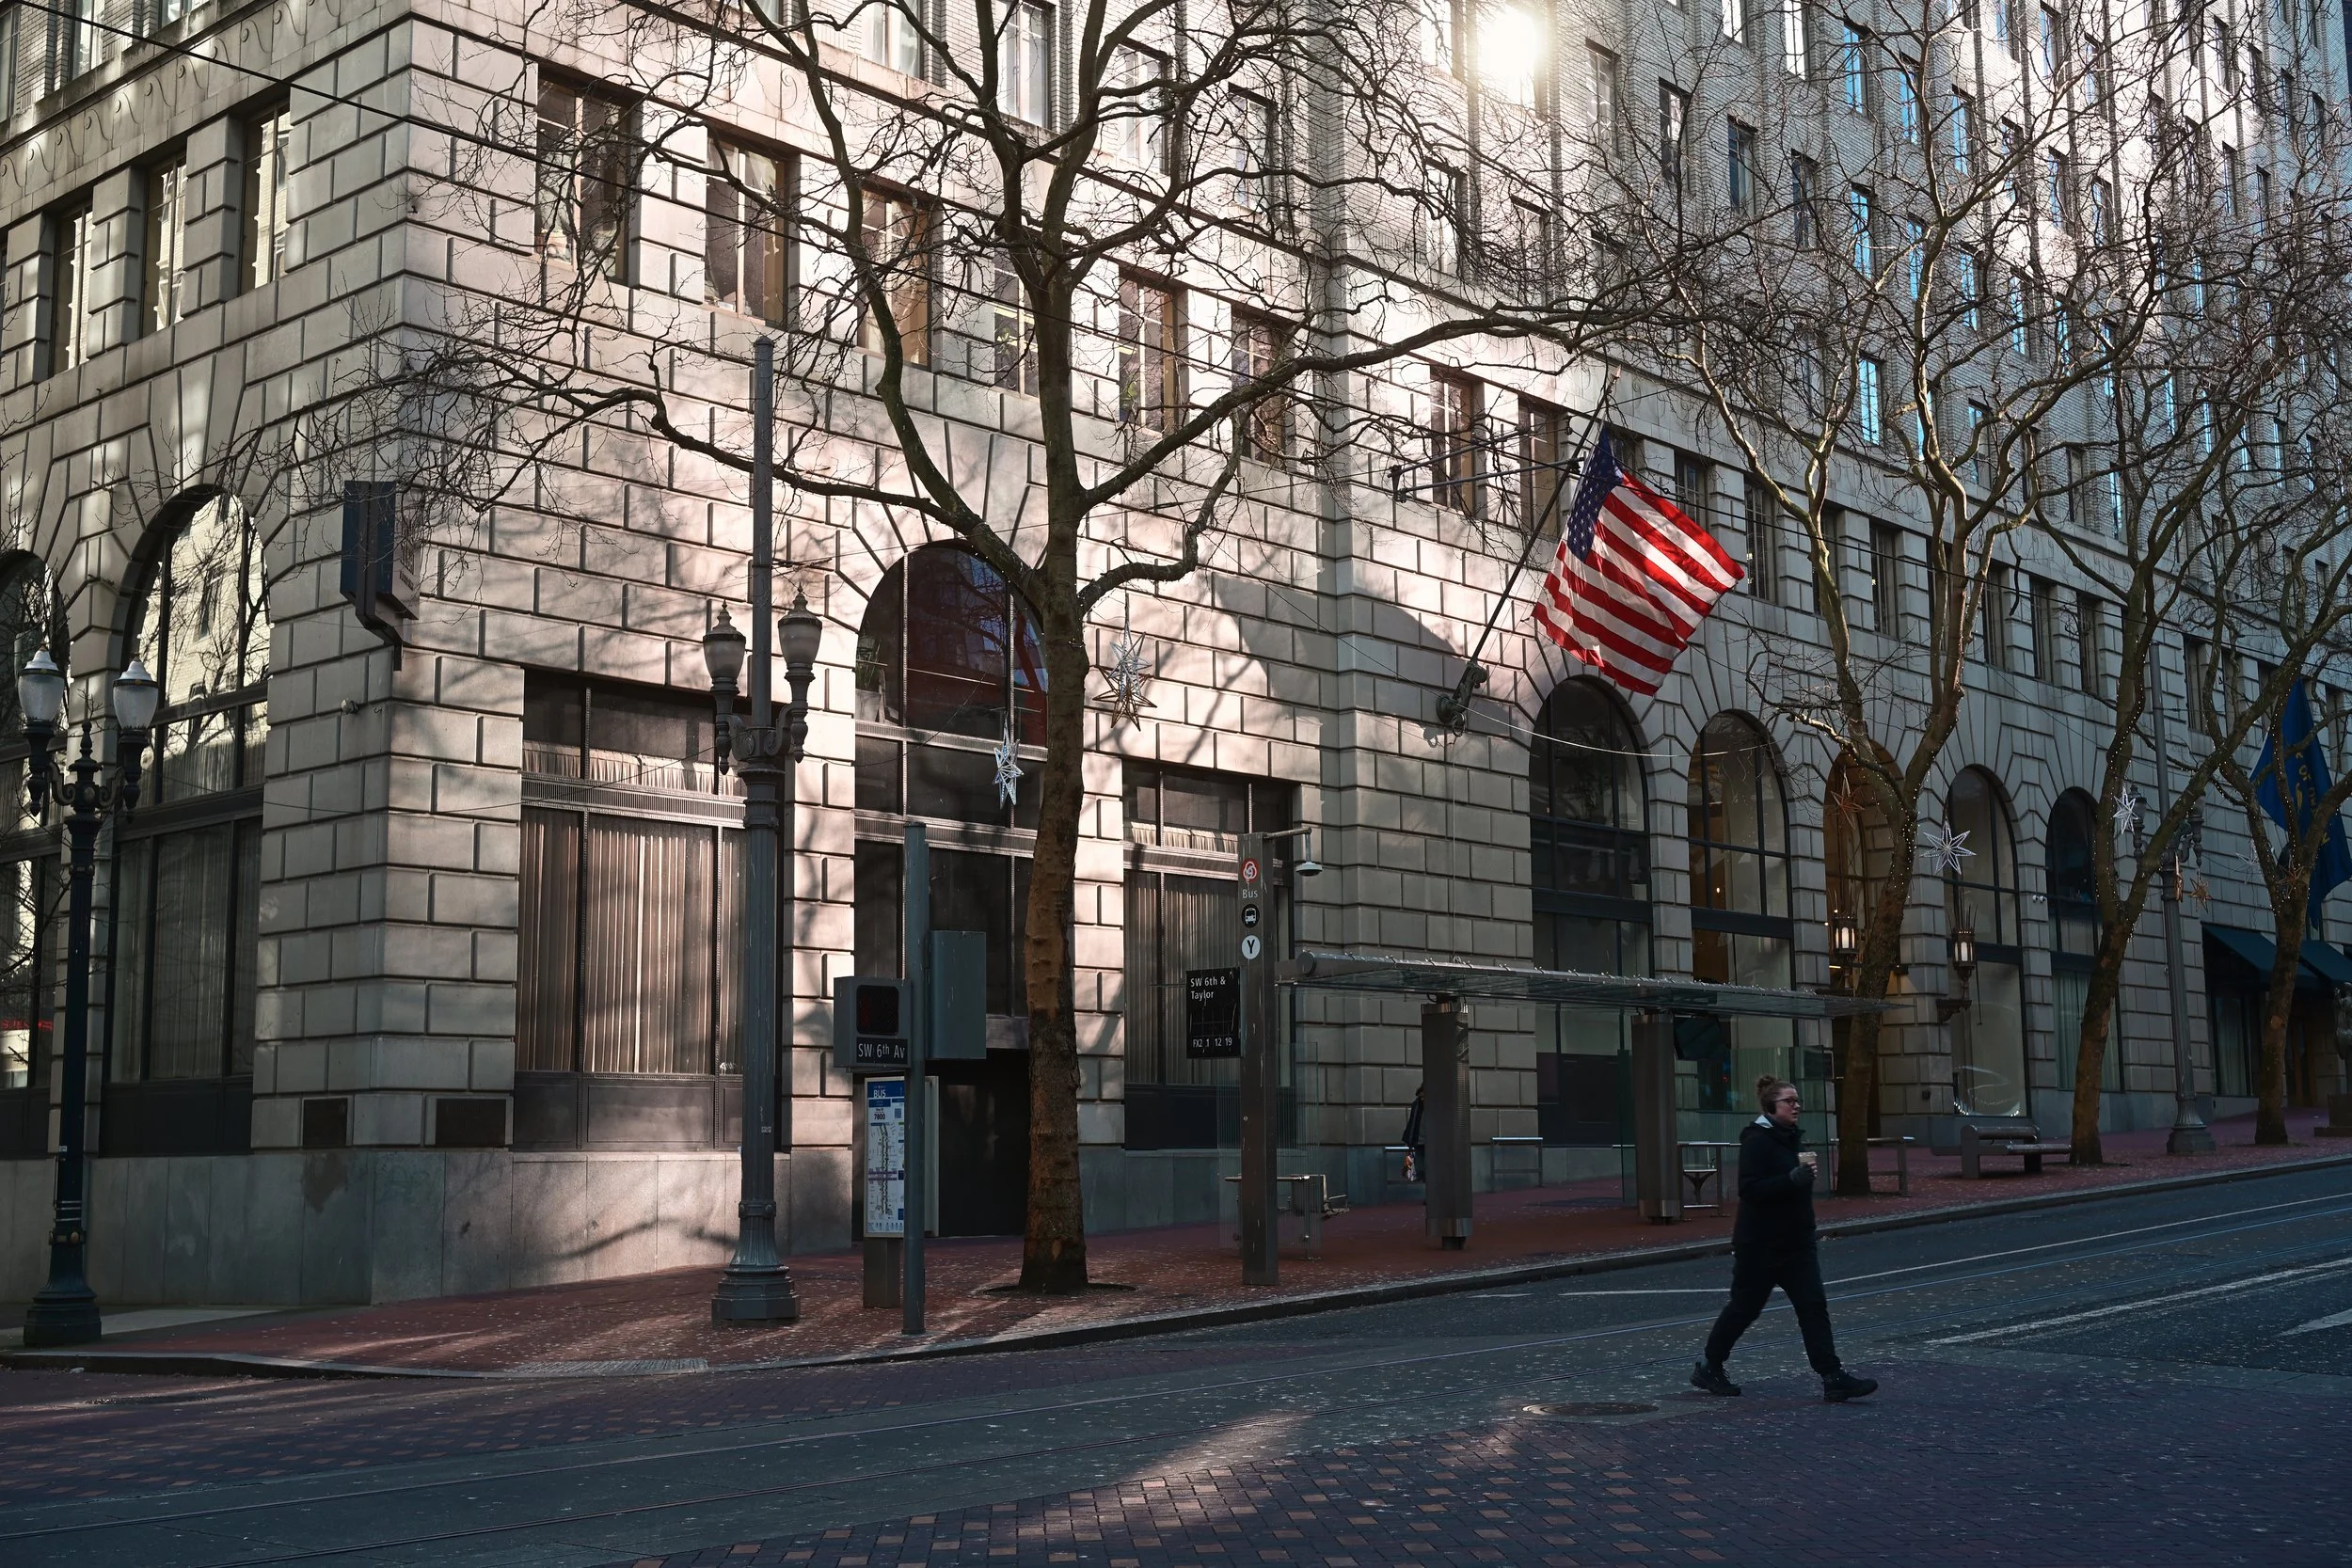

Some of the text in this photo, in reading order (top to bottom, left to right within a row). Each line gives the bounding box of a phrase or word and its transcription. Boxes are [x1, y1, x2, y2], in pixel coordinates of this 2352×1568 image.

[1243, 889, 1258, 899] Bus
[1248, 940, 1255, 954] Y
[1190, 976, 1226, 987] SW 6th &
[1190, 990, 1214, 1001] Taylor
[1193, 1037, 1232, 1048] FX2 1 12 19
[858, 1043, 905, 1059] SW 6th Av
[873, 1089, 886, 1098] BUS
